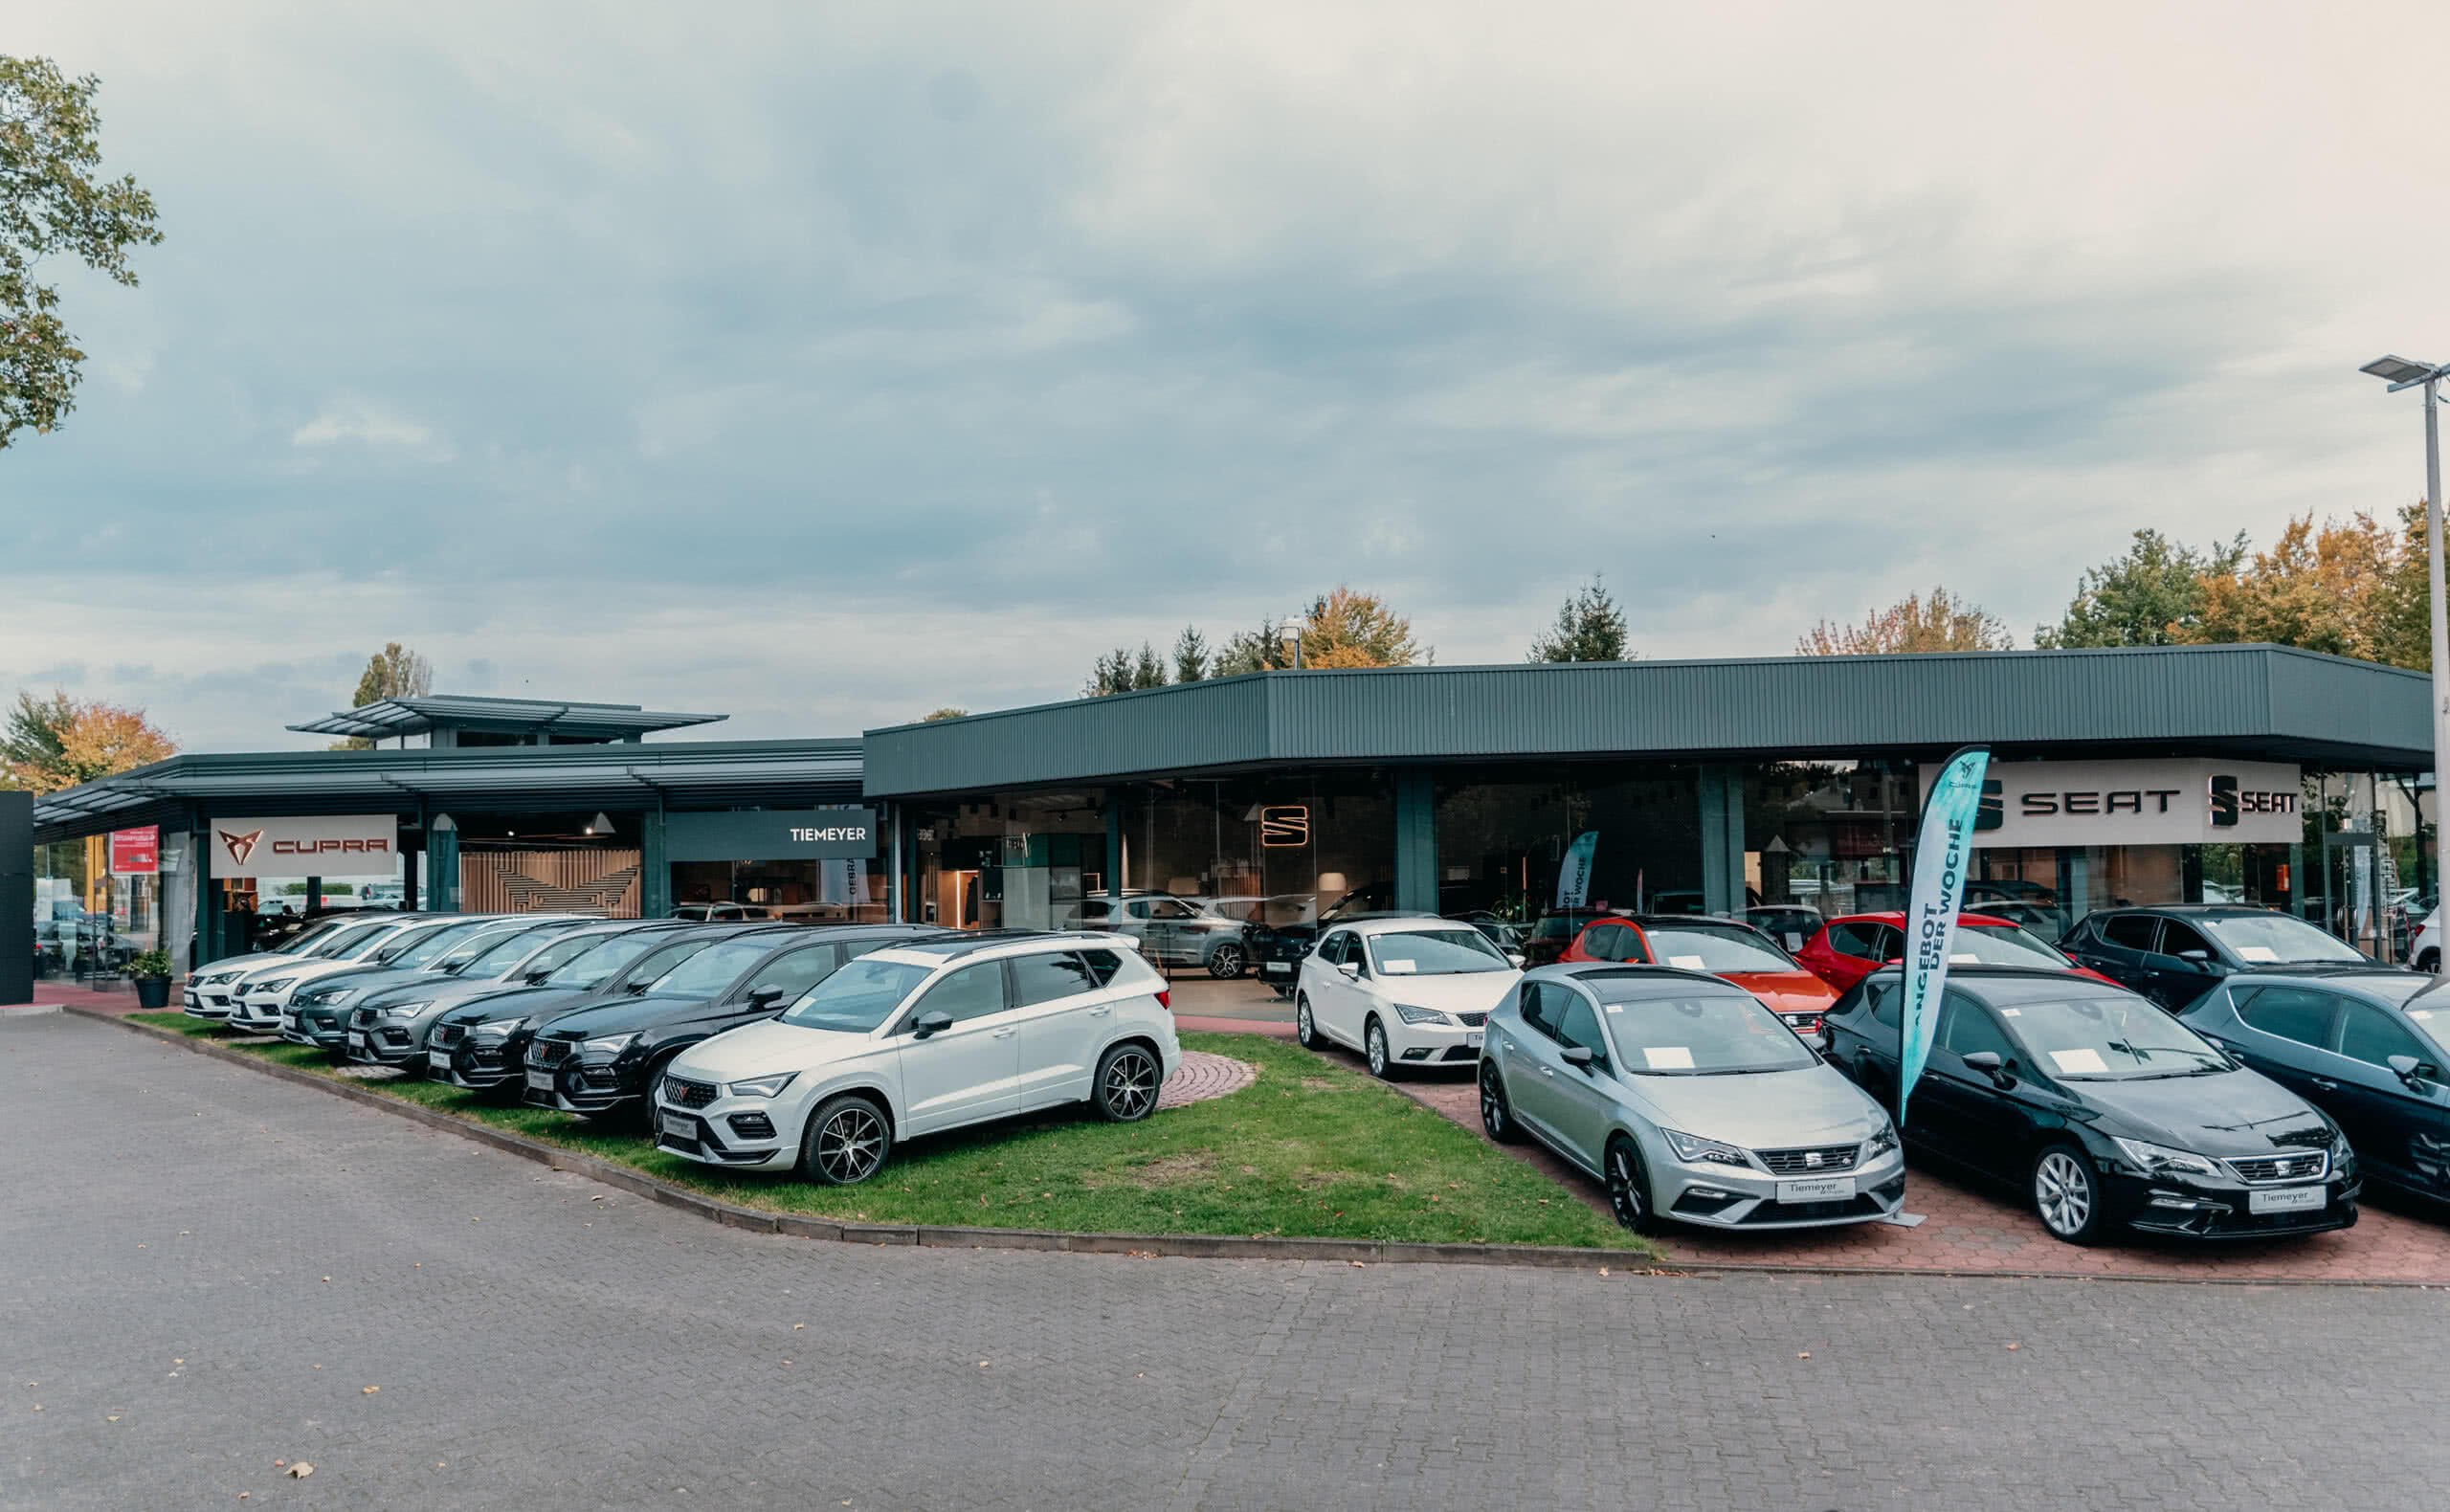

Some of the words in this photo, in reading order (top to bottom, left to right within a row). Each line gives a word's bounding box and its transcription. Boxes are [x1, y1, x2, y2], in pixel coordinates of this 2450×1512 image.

[2021, 789, 2182, 816] SEAT
[2239, 790, 2298, 813] SEAT
[790, 827, 866, 842] TIEMEYER
[273, 838, 390, 855] CUPRA
[1929, 921, 1947, 970] DER
[1939, 818, 1962, 916] WOCHE
[1914, 902, 1938, 1027] ANGEBOT
[1791, 1183, 1837, 1193] Tiemeyer
[2261, 1191, 2308, 1203] Tiemeyer
